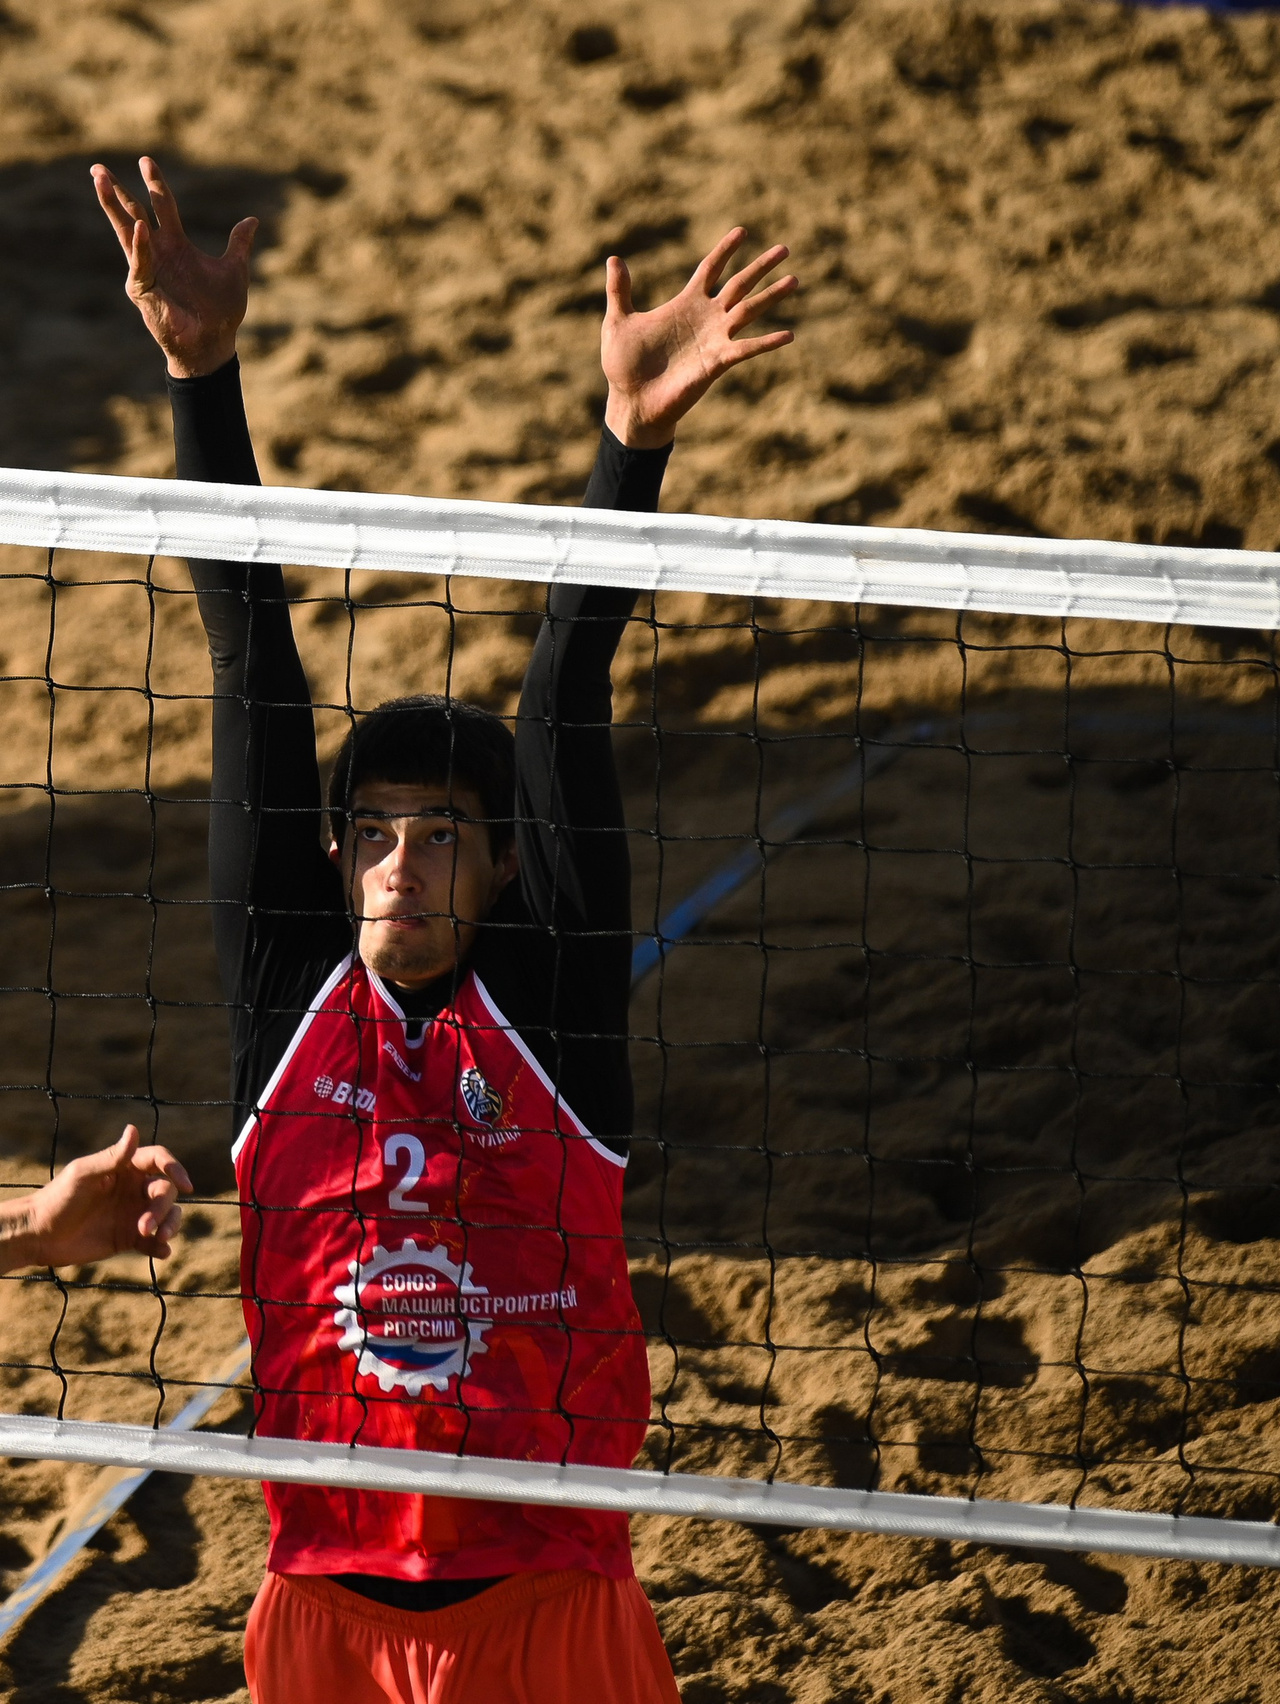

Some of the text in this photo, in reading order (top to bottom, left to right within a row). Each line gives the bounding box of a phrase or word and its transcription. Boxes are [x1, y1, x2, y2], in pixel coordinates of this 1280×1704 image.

[384, 1133, 430, 1213] 2
[382, 1273, 437, 1292] СОЮЗ
[382, 1285, 578, 1315] МАШИНОСТРОИТЕЛЕЙ
[383, 1320, 456, 1338] РОССИИ
